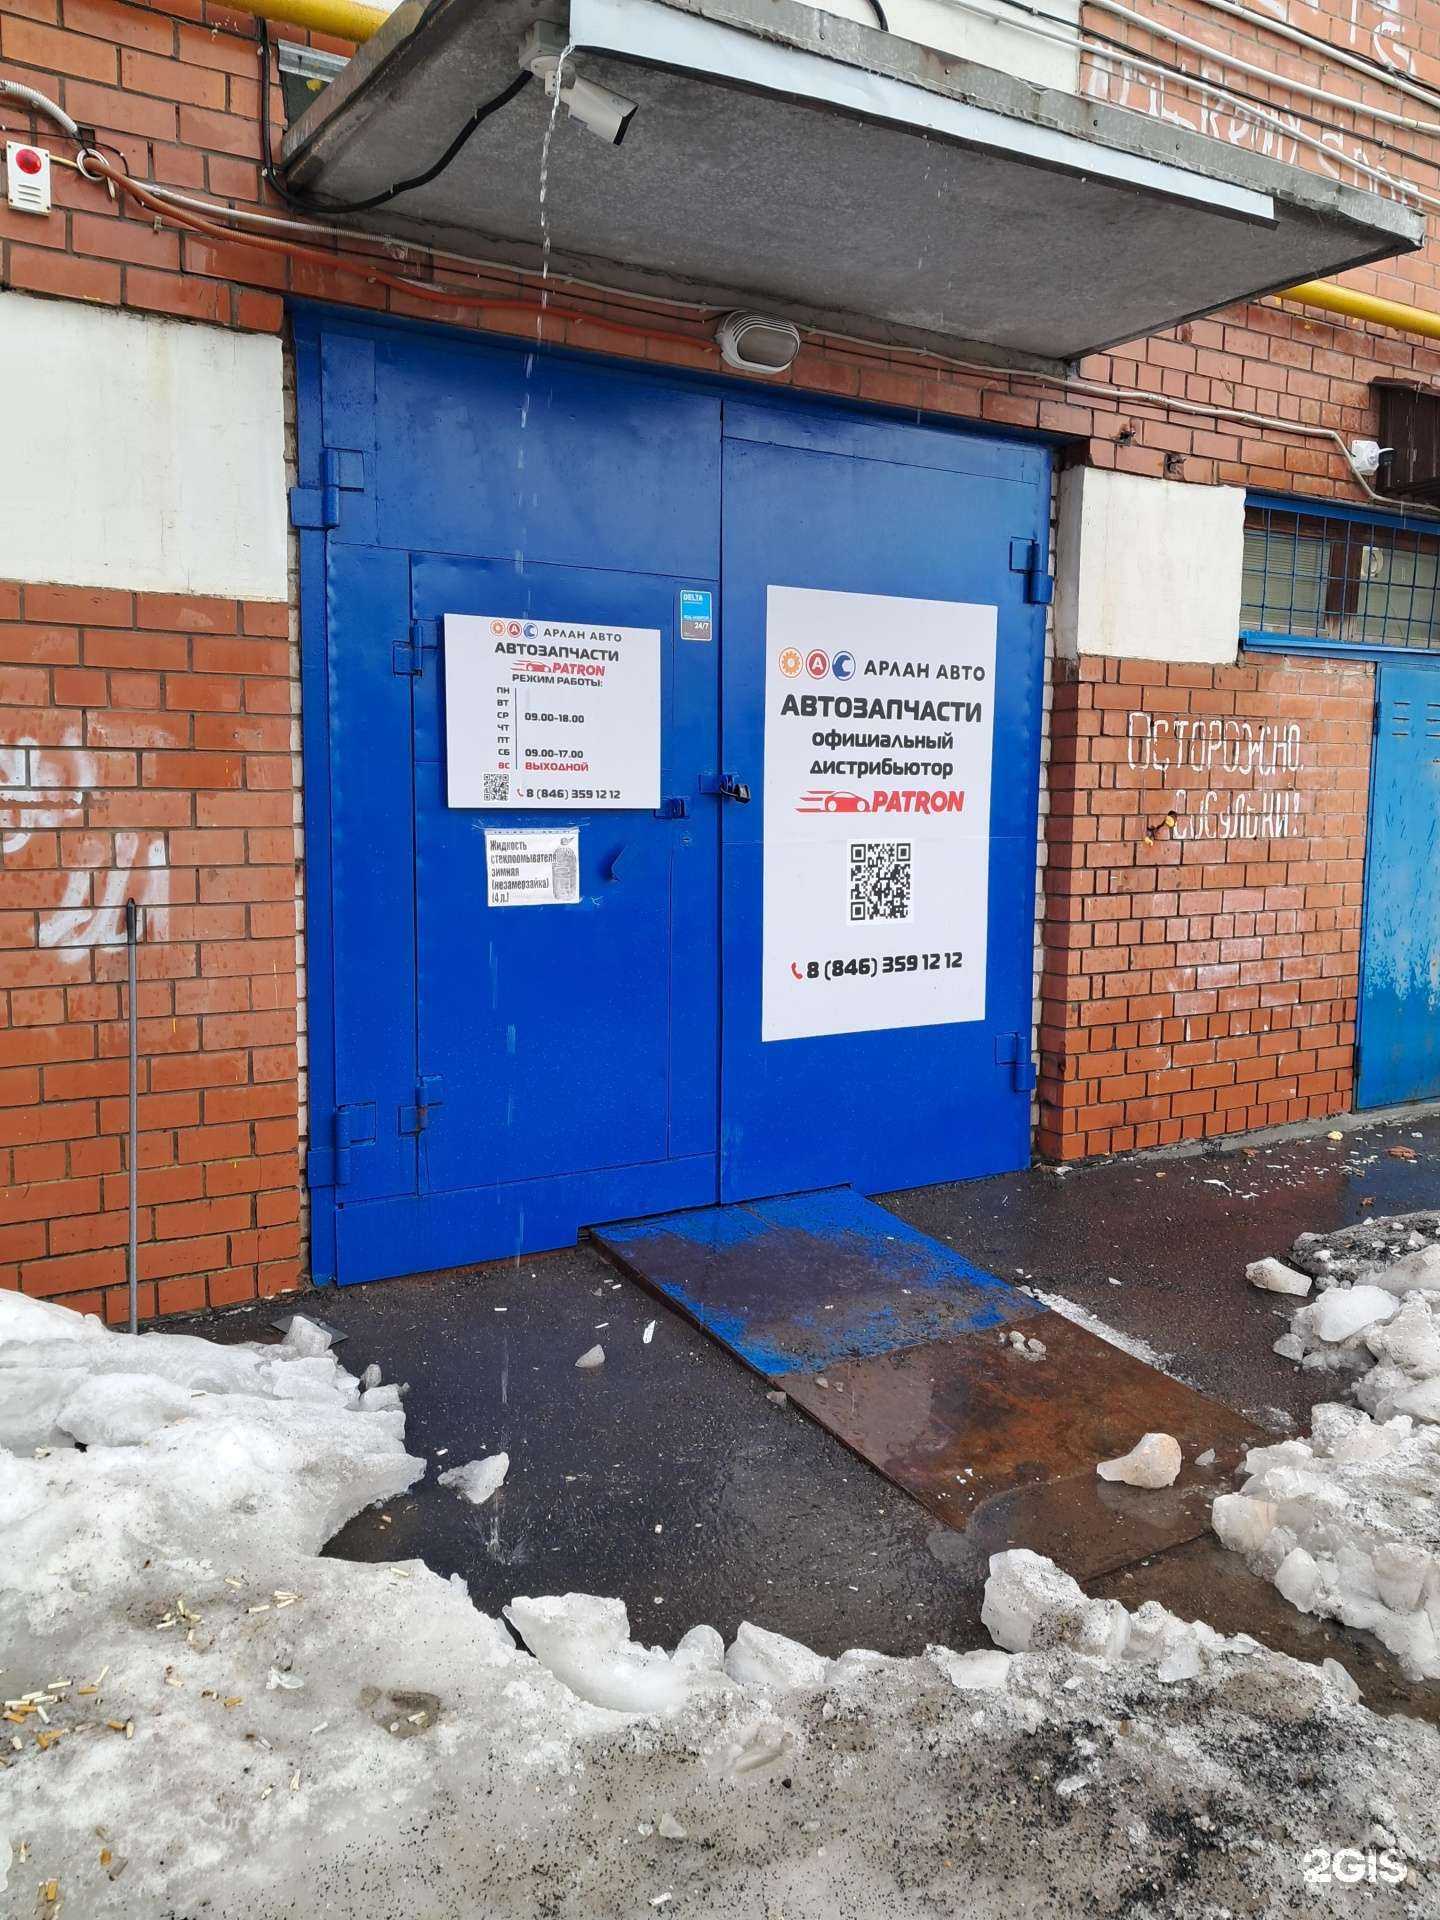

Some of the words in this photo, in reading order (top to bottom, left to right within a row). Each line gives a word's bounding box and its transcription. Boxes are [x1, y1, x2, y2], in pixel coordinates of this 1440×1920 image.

[543, 628, 586, 640] АРЛАН
[589, 632, 622, 642] АВТО
[495, 642, 619, 662] АВТОЗАПЧАСТИ
[552, 662, 606, 677] PATRON
[864, 660, 930, 679] АРЛАН
[936, 664, 986, 681] АВТО
[512, 674, 555, 684] РЕЖИМ
[556, 676, 603, 687] РАБОТЫ:
[497, 699, 509, 707] ВТ
[780, 694, 982, 723] АВТОЗАПЧАСТИ
[524, 712, 585, 724] 09.00-18.00
[812, 729, 953, 750] официальный
[498, 748, 510, 756] СБ
[524, 748, 584, 758] 09.00-17.00
[525, 761, 589, 772] ВЫХОДНОЙ
[810, 758, 953, 779] дистрибьютор
[526, 788, 534, 799] 8
[536, 789, 569, 800] (846)
[571, 790, 593, 799] 359
[595, 790, 607, 799] 12
[609, 790, 621, 799] 12
[871, 790, 965, 815] PATRON
[490, 840, 527, 851] Жидкость
[491, 877, 549, 890] (незамерзайка)
[806, 961, 820, 978] 8
[824, 957, 877, 981] (846)
[882, 955, 918, 973] 359
[922, 953, 940, 970] 12
[944, 952, 963, 968] 12
